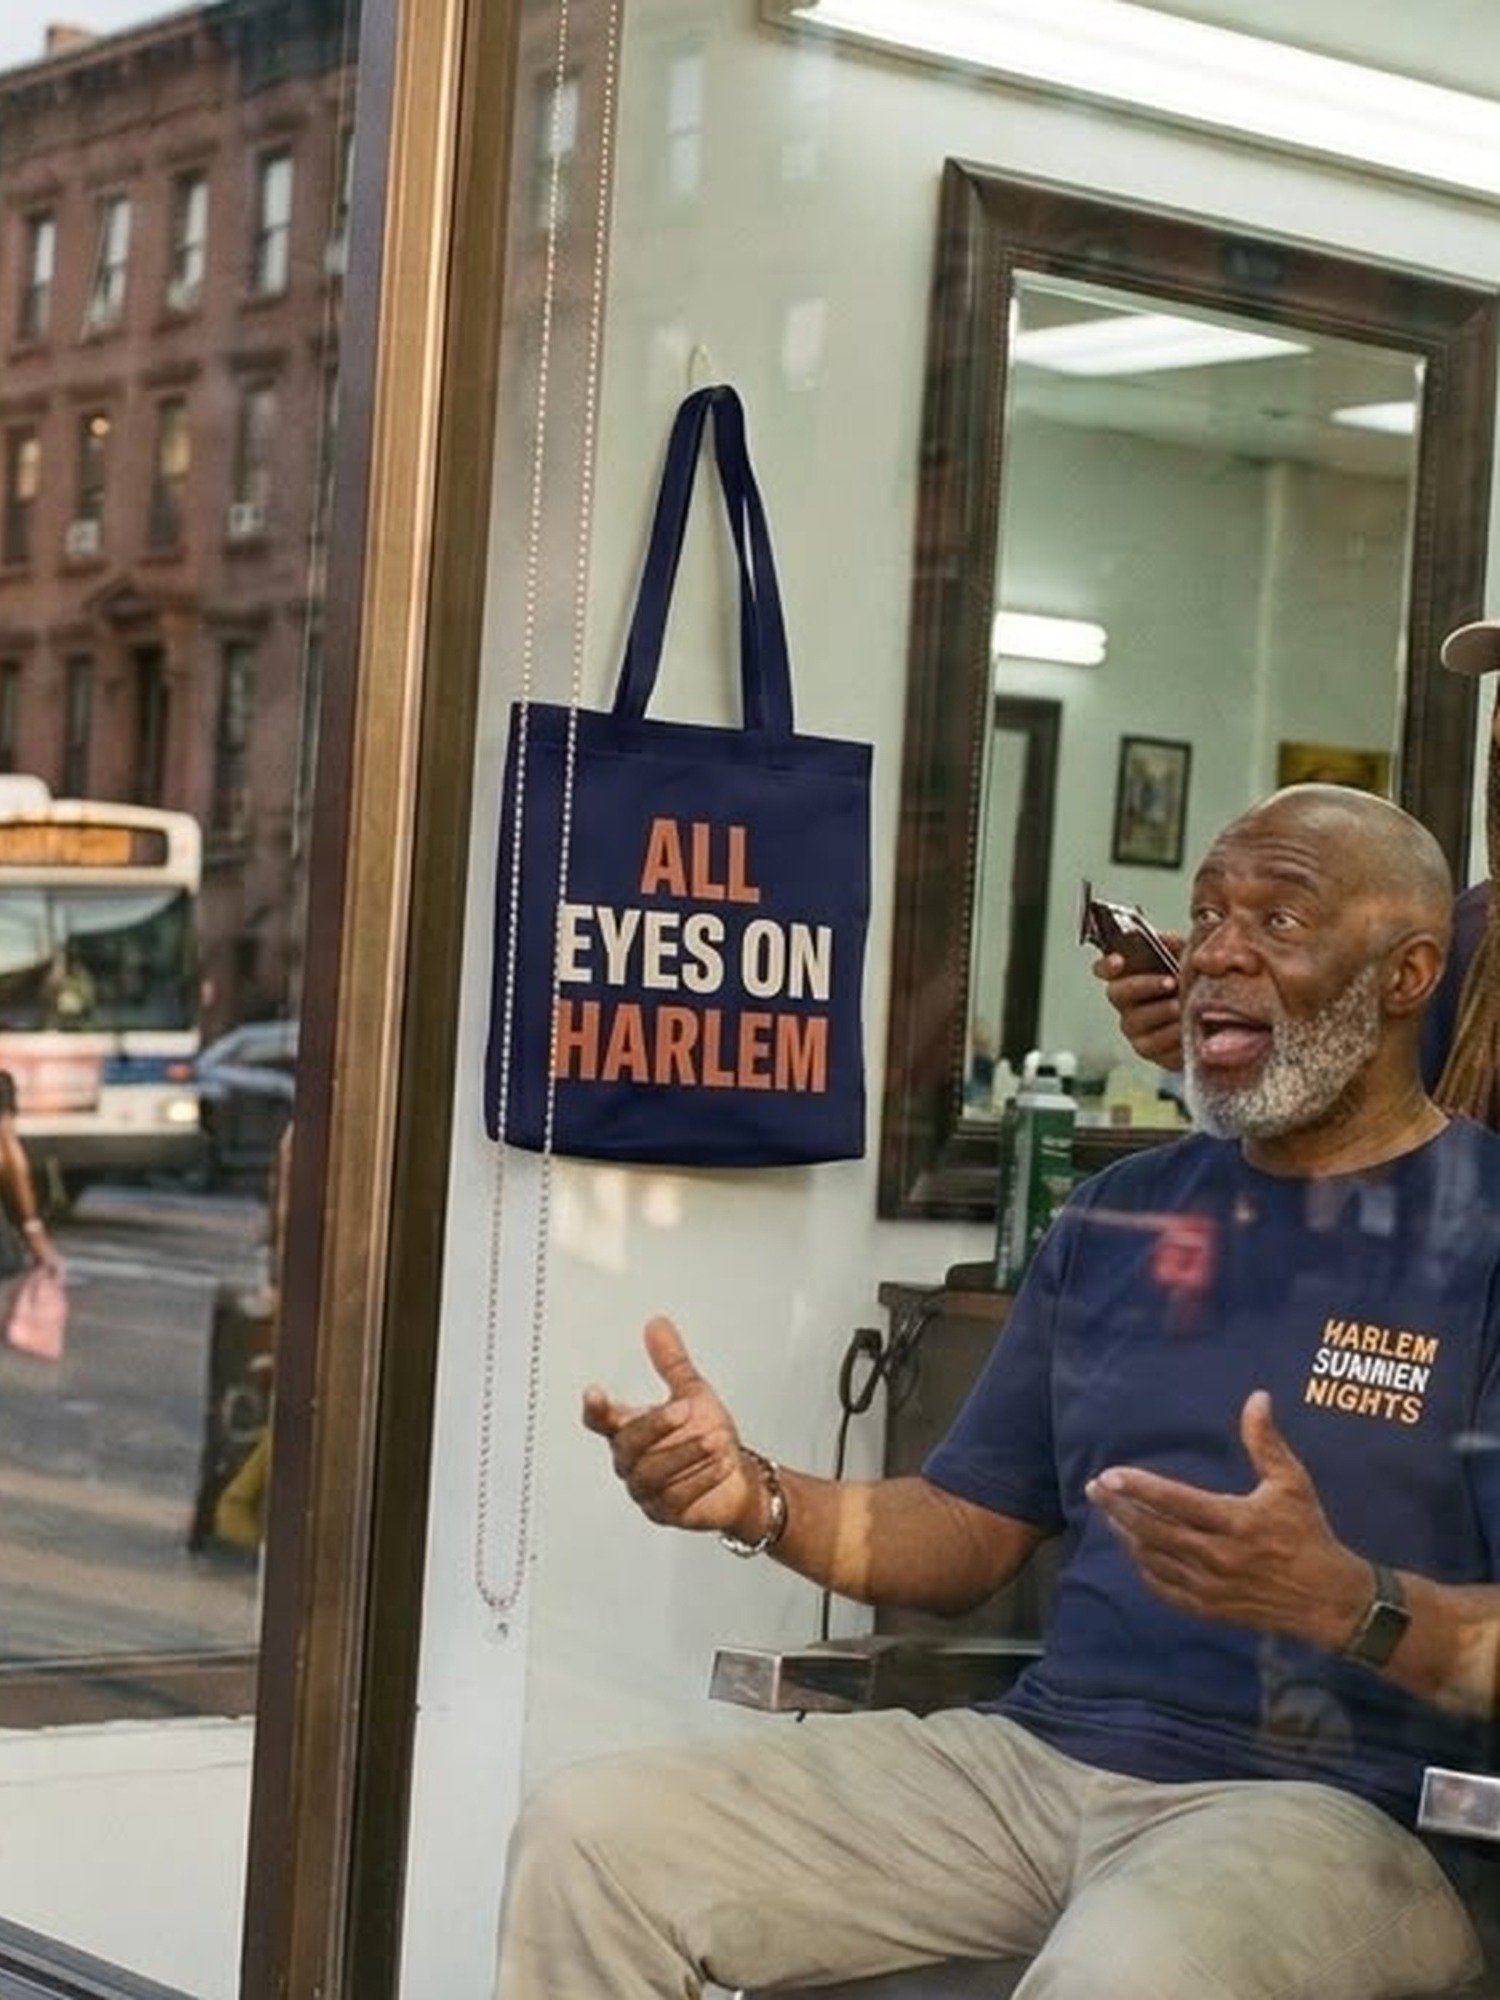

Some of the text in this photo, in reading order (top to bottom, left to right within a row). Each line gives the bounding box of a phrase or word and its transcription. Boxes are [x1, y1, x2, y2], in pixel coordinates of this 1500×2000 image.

[641, 818, 760, 902] ALL
[557, 903, 832, 1000] EYES ON
[553, 999, 828, 1092] HARLEM
[1322, 1319, 1439, 1364] HARLEM
[1304, 1378, 1423, 1424] NIGHTS
